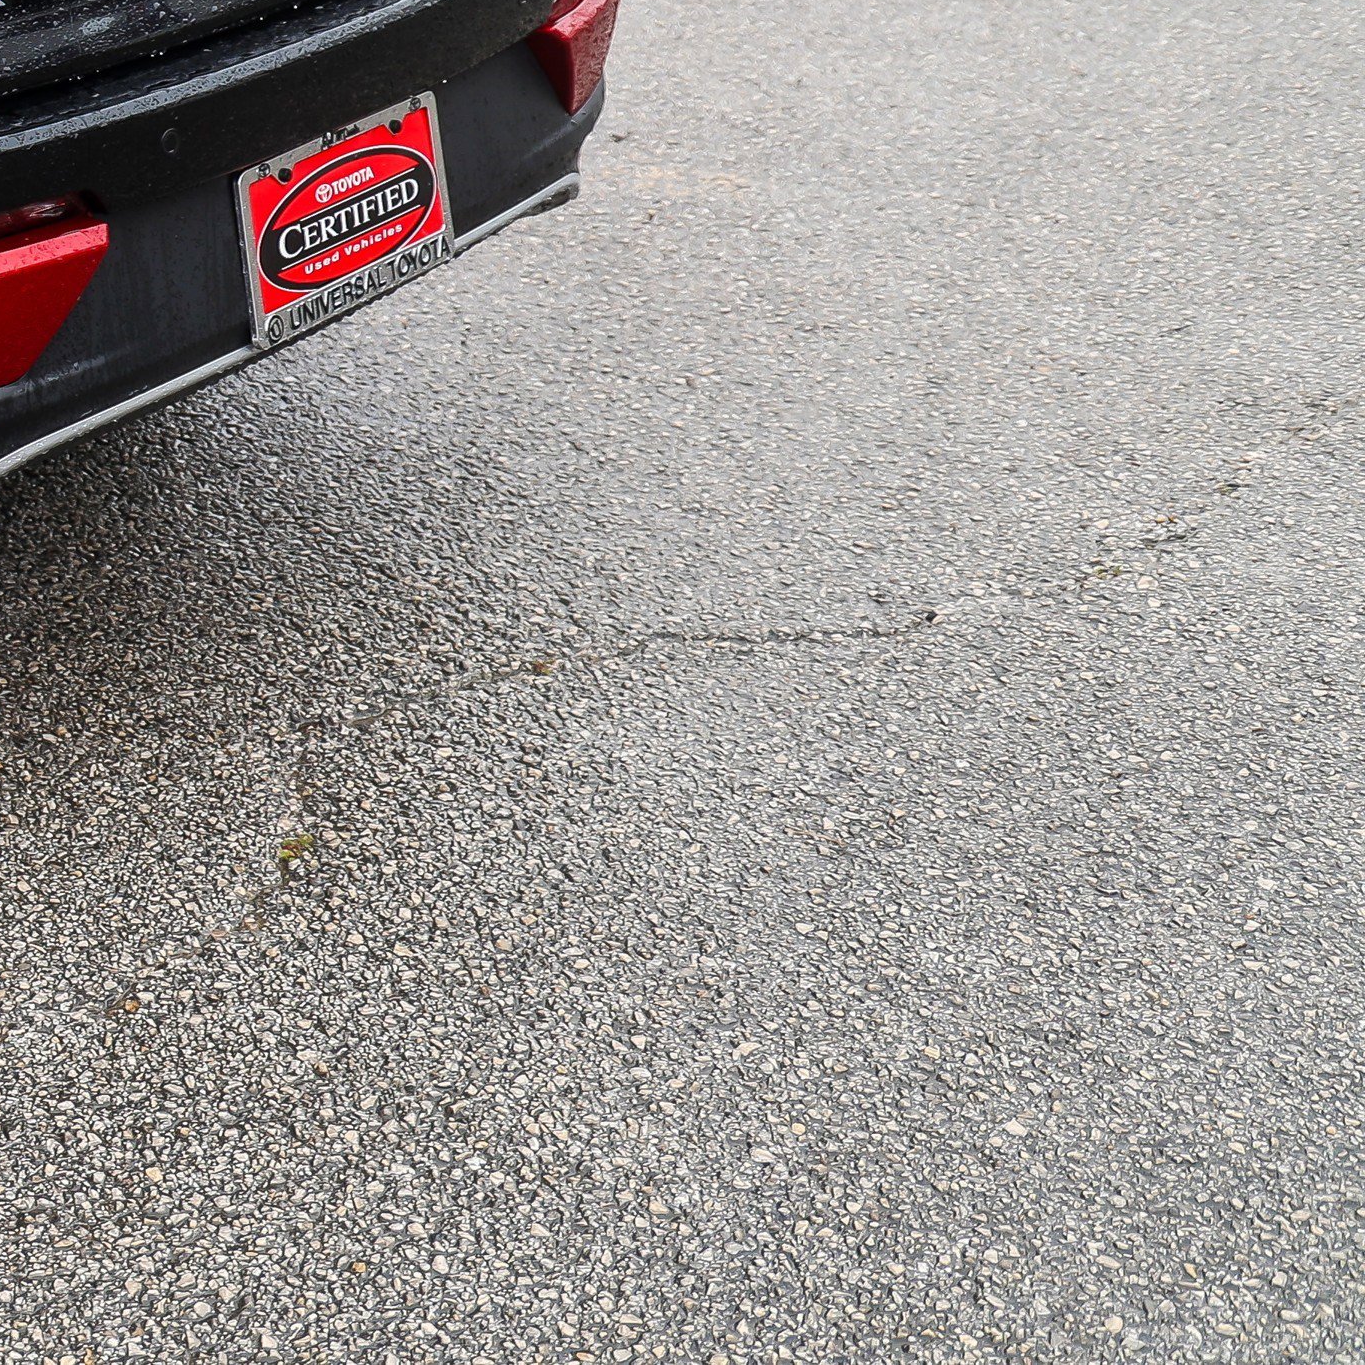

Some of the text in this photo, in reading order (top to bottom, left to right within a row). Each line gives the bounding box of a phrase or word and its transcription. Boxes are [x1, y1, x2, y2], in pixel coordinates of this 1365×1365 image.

[331, 166, 375, 195] TOYOTA
[279, 178, 419, 259] CERTIFIED
[304, 224, 403, 275] Used Vehicles
[289, 269, 387, 330] UNIVERSAL
[388, 236, 451, 281] TOYOTA
